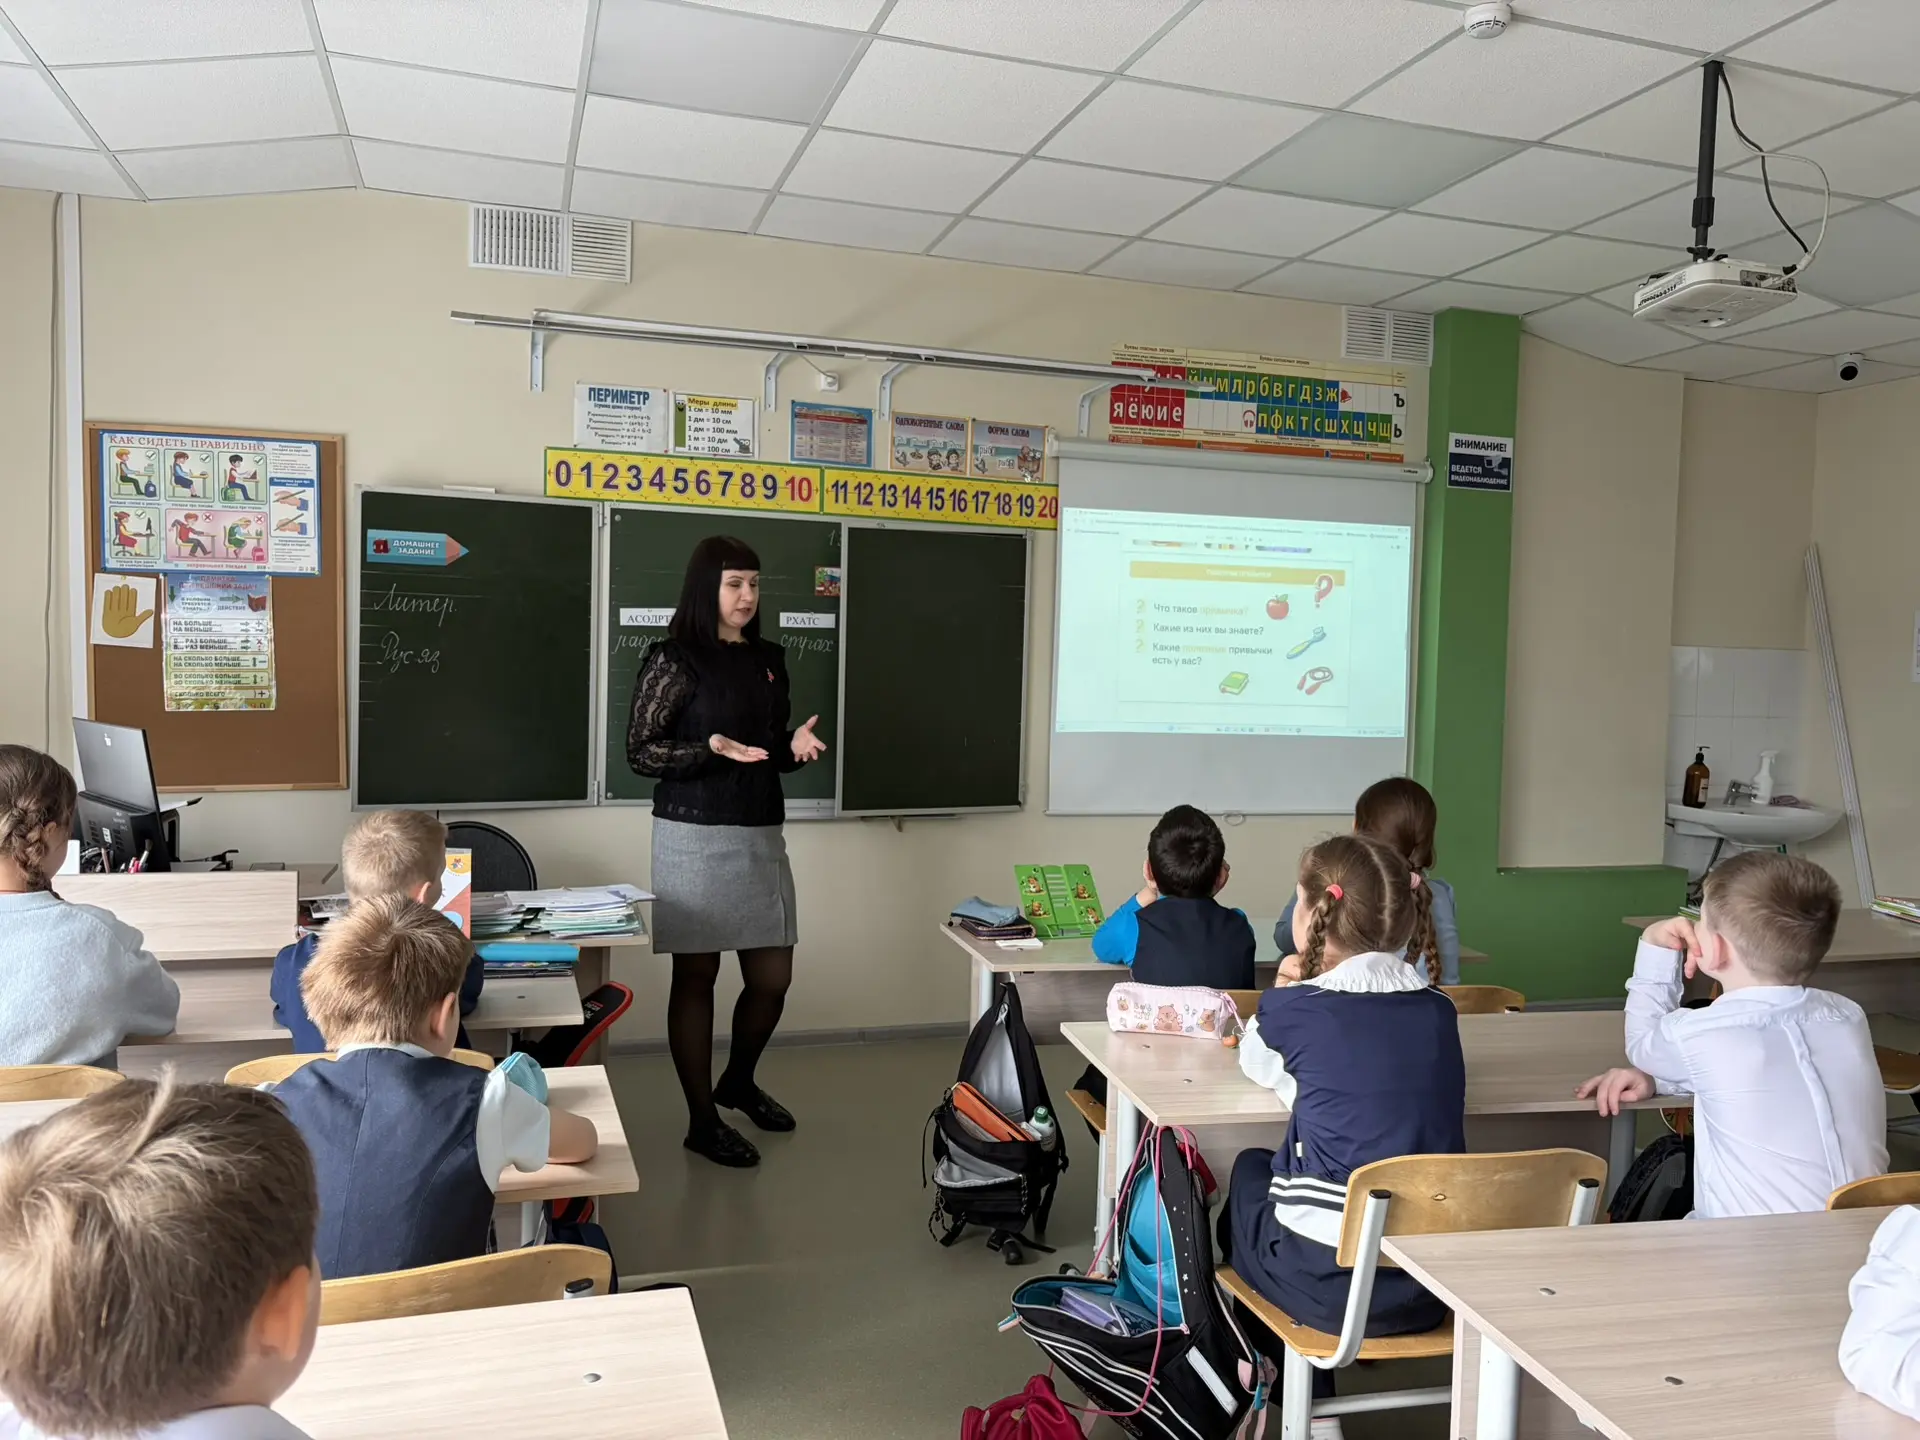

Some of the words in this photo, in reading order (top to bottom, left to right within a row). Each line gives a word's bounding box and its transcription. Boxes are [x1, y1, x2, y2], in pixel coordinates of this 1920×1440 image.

[588, 387, 650, 405] ПЕРИМЕТР
[1216, 377, 1228, 393] м
[1232, 378, 1242, 394] л
[1246, 379, 1256, 400] р
[1259, 376, 1269, 396] б
[1273, 382, 1282, 397] в
[1288, 383, 1296, 398] г
[1300, 385, 1311, 405] д
[1315, 386, 1323, 401] з
[1326, 387, 1338, 402] ж
[688, 398, 709, 406] Меры
[896, 416, 943, 429] ОДНОКОРЕННЫЕ
[945, 421, 965, 431] СЛОВА
[1113, 402, 1123, 418] я
[1128, 397, 1138, 419] ё
[1142, 404, 1154, 420] ю
[1157, 405, 1168, 421] и
[1172, 406, 1182, 421] е
[1257, 413, 1267, 427] п
[1271, 409, 1282, 433] ф
[1286, 414, 1294, 430] к
[1300, 417, 1308, 431] т
[1314, 417, 1321, 432] с
[1325, 419, 1337, 433] ш
[1341, 419, 1349, 434] х
[1353, 420, 1363, 438] ц
[1368, 421, 1376, 435] ч
[1379, 422, 1391, 440] щ
[988, 425, 1009, 436] ФОРМА
[1011, 428, 1030, 438] СЛОВА
[109, 435, 134, 445] КАК
[138, 437, 187, 448] СИДЕТЬ
[191, 439, 266, 451] ПРАВИЛЬНО
[1454, 439, 1507, 452] ВНИМАНИЕ!
[1451, 464, 1482, 475] ВЕДЕТСЯ
[555, 460, 572, 487] 0
[580, 461, 593, 488] 1
[602, 463, 620, 490] 2
[626, 464, 643, 491] 3
[649, 466, 666, 492] 4
[673, 468, 689, 495] 5
[695, 469, 712, 496] 6
[717, 470, 734, 497] 7
[740, 472, 756, 499] 8
[762, 474, 778, 500] 9
[785, 475, 813, 502] 10
[1451, 474, 1508, 485] ВИДЕОНАБЛЮДЕНИЕ
[831, 480, 849, 505] 11
[854, 481, 874, 506] 12
[879, 482, 898, 508] 13
[902, 485, 922, 510] 14
[926, 487, 945, 512] 15
[949, 488, 968, 513] 16
[972, 490, 990, 515] 17
[994, 492, 1012, 516] 18
[1016, 493, 1035, 518] 19
[1038, 496, 1058, 519] 20
[393, 539, 440, 549] ДОМАШНЕЕ
[398, 547, 435, 556] ЗАДАНИЕ
[1154, 603, 1171, 613] Что
[627, 614, 674, 625] АСОДРТ
[786, 616, 820, 626] РХАТС
[1153, 623, 1181, 633] Какие
[1183, 625, 1194, 633] из
[1196, 625, 1212, 634] них
[1214, 626, 1227, 634] вы
[1229, 626, 1264, 635] знаете?
[780, 633, 834, 660] страх
[1152, 642, 1180, 652] Какие
[1229, 646, 1273, 655] привычки
[1152, 657, 1172, 665] есть
[1174, 657, 1179, 666] у
[1182, 657, 1202, 666] вас?
